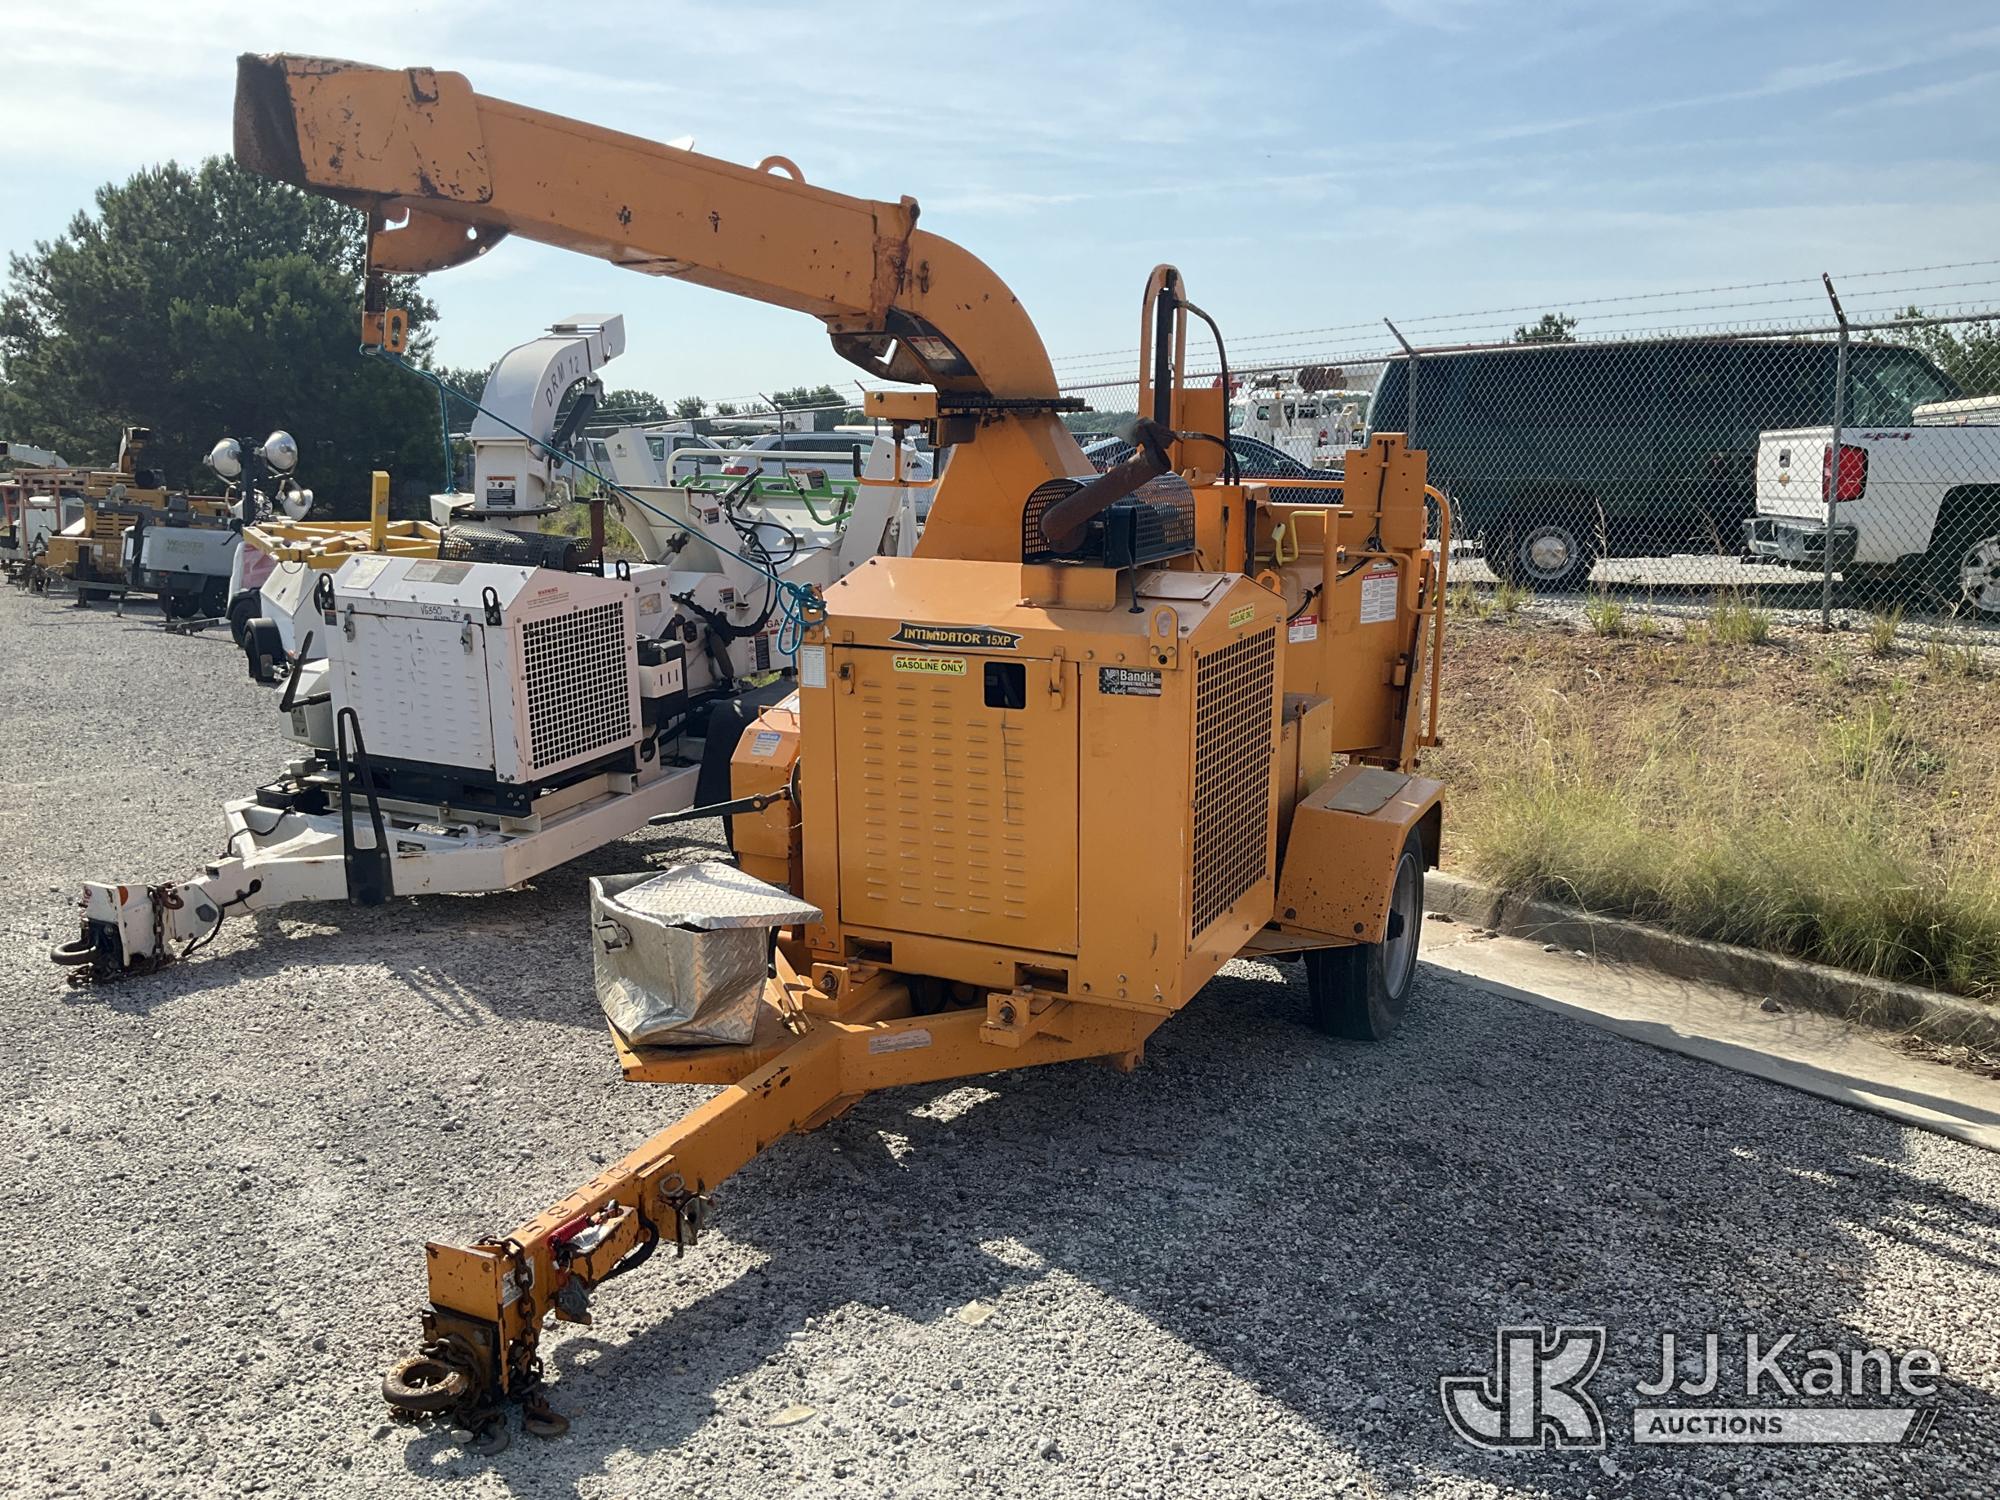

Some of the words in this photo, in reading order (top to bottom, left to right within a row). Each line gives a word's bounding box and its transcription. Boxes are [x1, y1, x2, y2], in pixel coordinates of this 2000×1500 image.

[545, 361, 565, 408] DRM
[904, 627, 981, 644] INTIMIDATOR
[986, 634, 1012, 646] 15XP
[895, 659, 939, 671] GASOLINE
[940, 662, 964, 673] ONLY
[1120, 670, 1154, 683] Bandit
